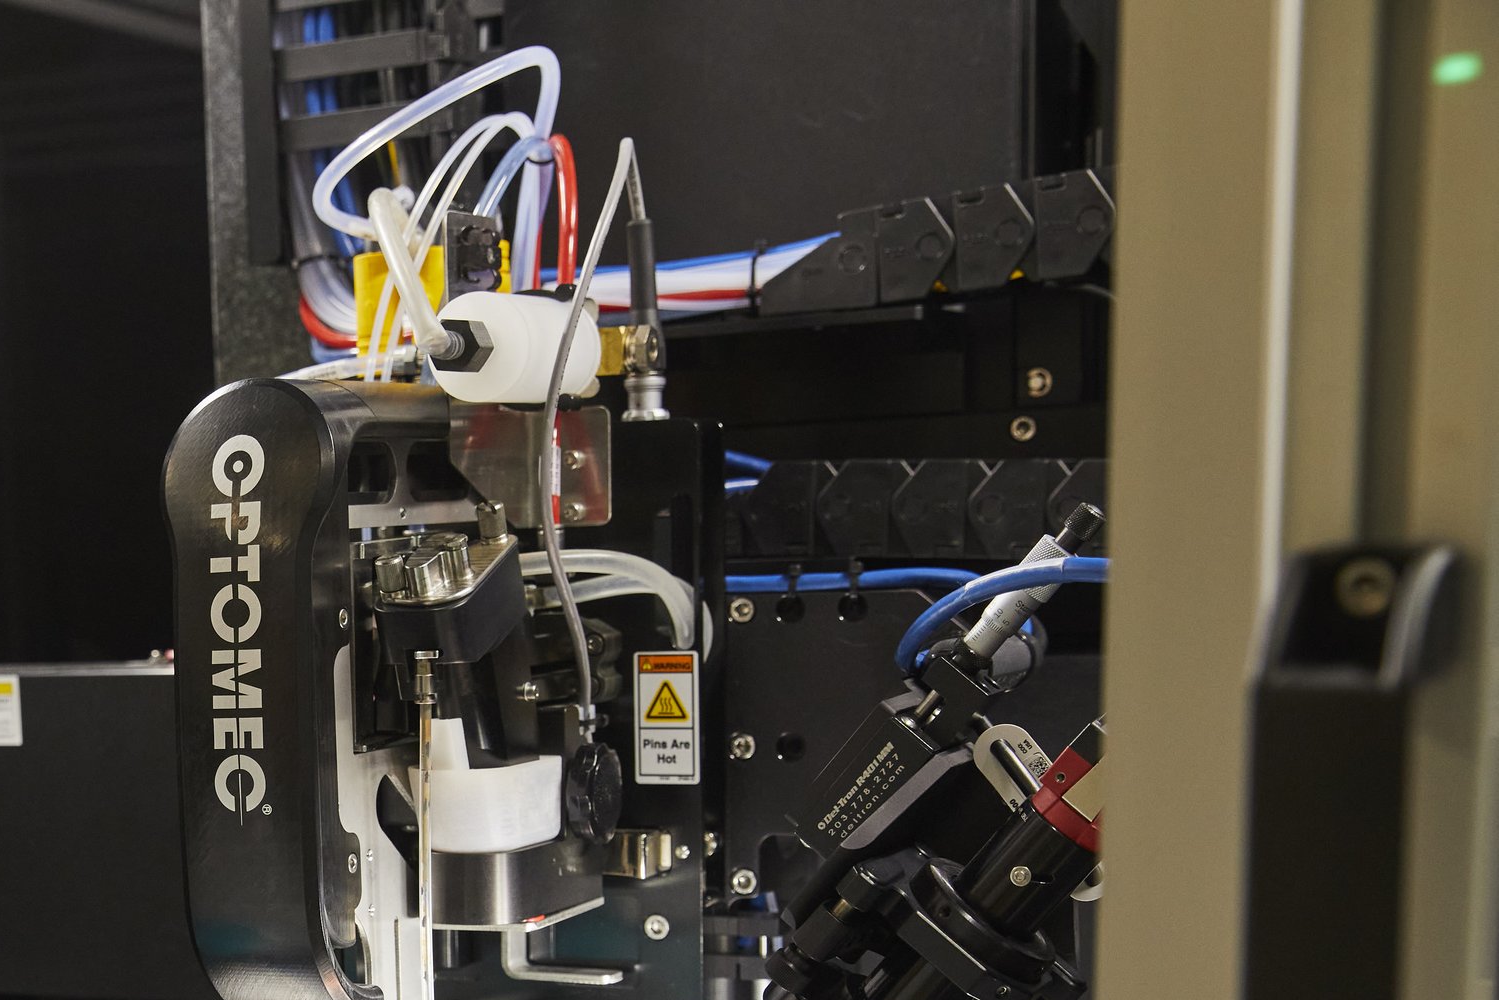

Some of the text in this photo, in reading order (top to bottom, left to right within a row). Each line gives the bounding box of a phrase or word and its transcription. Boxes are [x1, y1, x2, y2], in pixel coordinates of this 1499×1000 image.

[643, 739, 691, 749] Pins Are
[657, 754, 677, 764] Hot
[824, 785, 859, 825] Del-Tron
[828, 753, 900, 836] 203.778.2727
[841, 765, 905, 838] deltron.com
